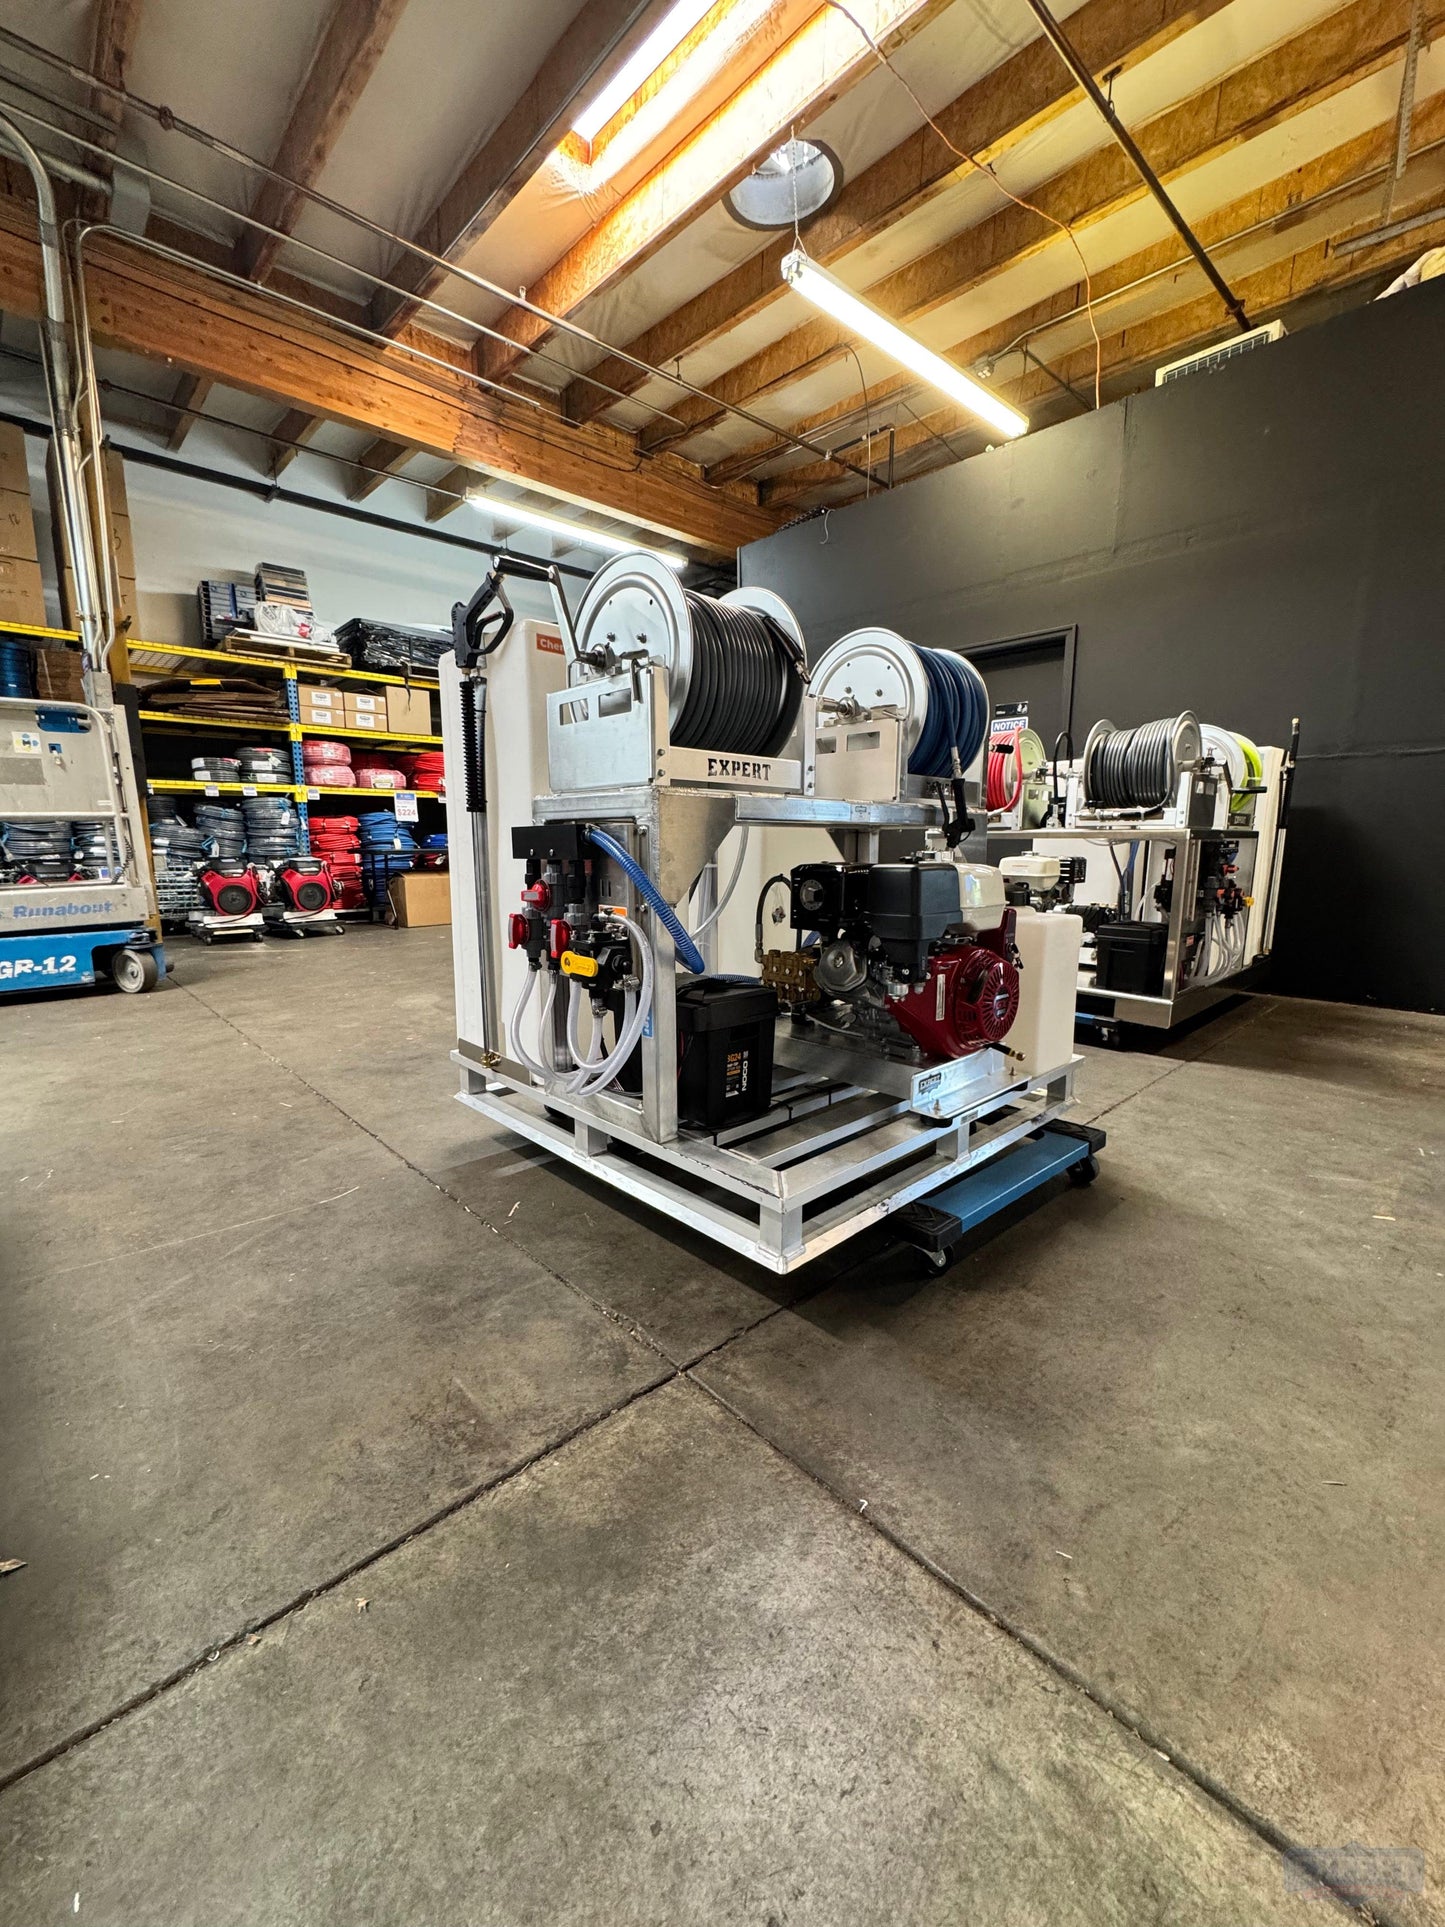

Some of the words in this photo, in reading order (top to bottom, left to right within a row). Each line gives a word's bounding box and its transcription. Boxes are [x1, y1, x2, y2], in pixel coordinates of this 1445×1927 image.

[993, 720, 1025, 730] NOTICE
[707, 758, 771, 781] EXPERT
[397, 808, 416, 816] $224
[13, 902, 113, 919] Runabout
[0, 955, 77, 979] GR-12
